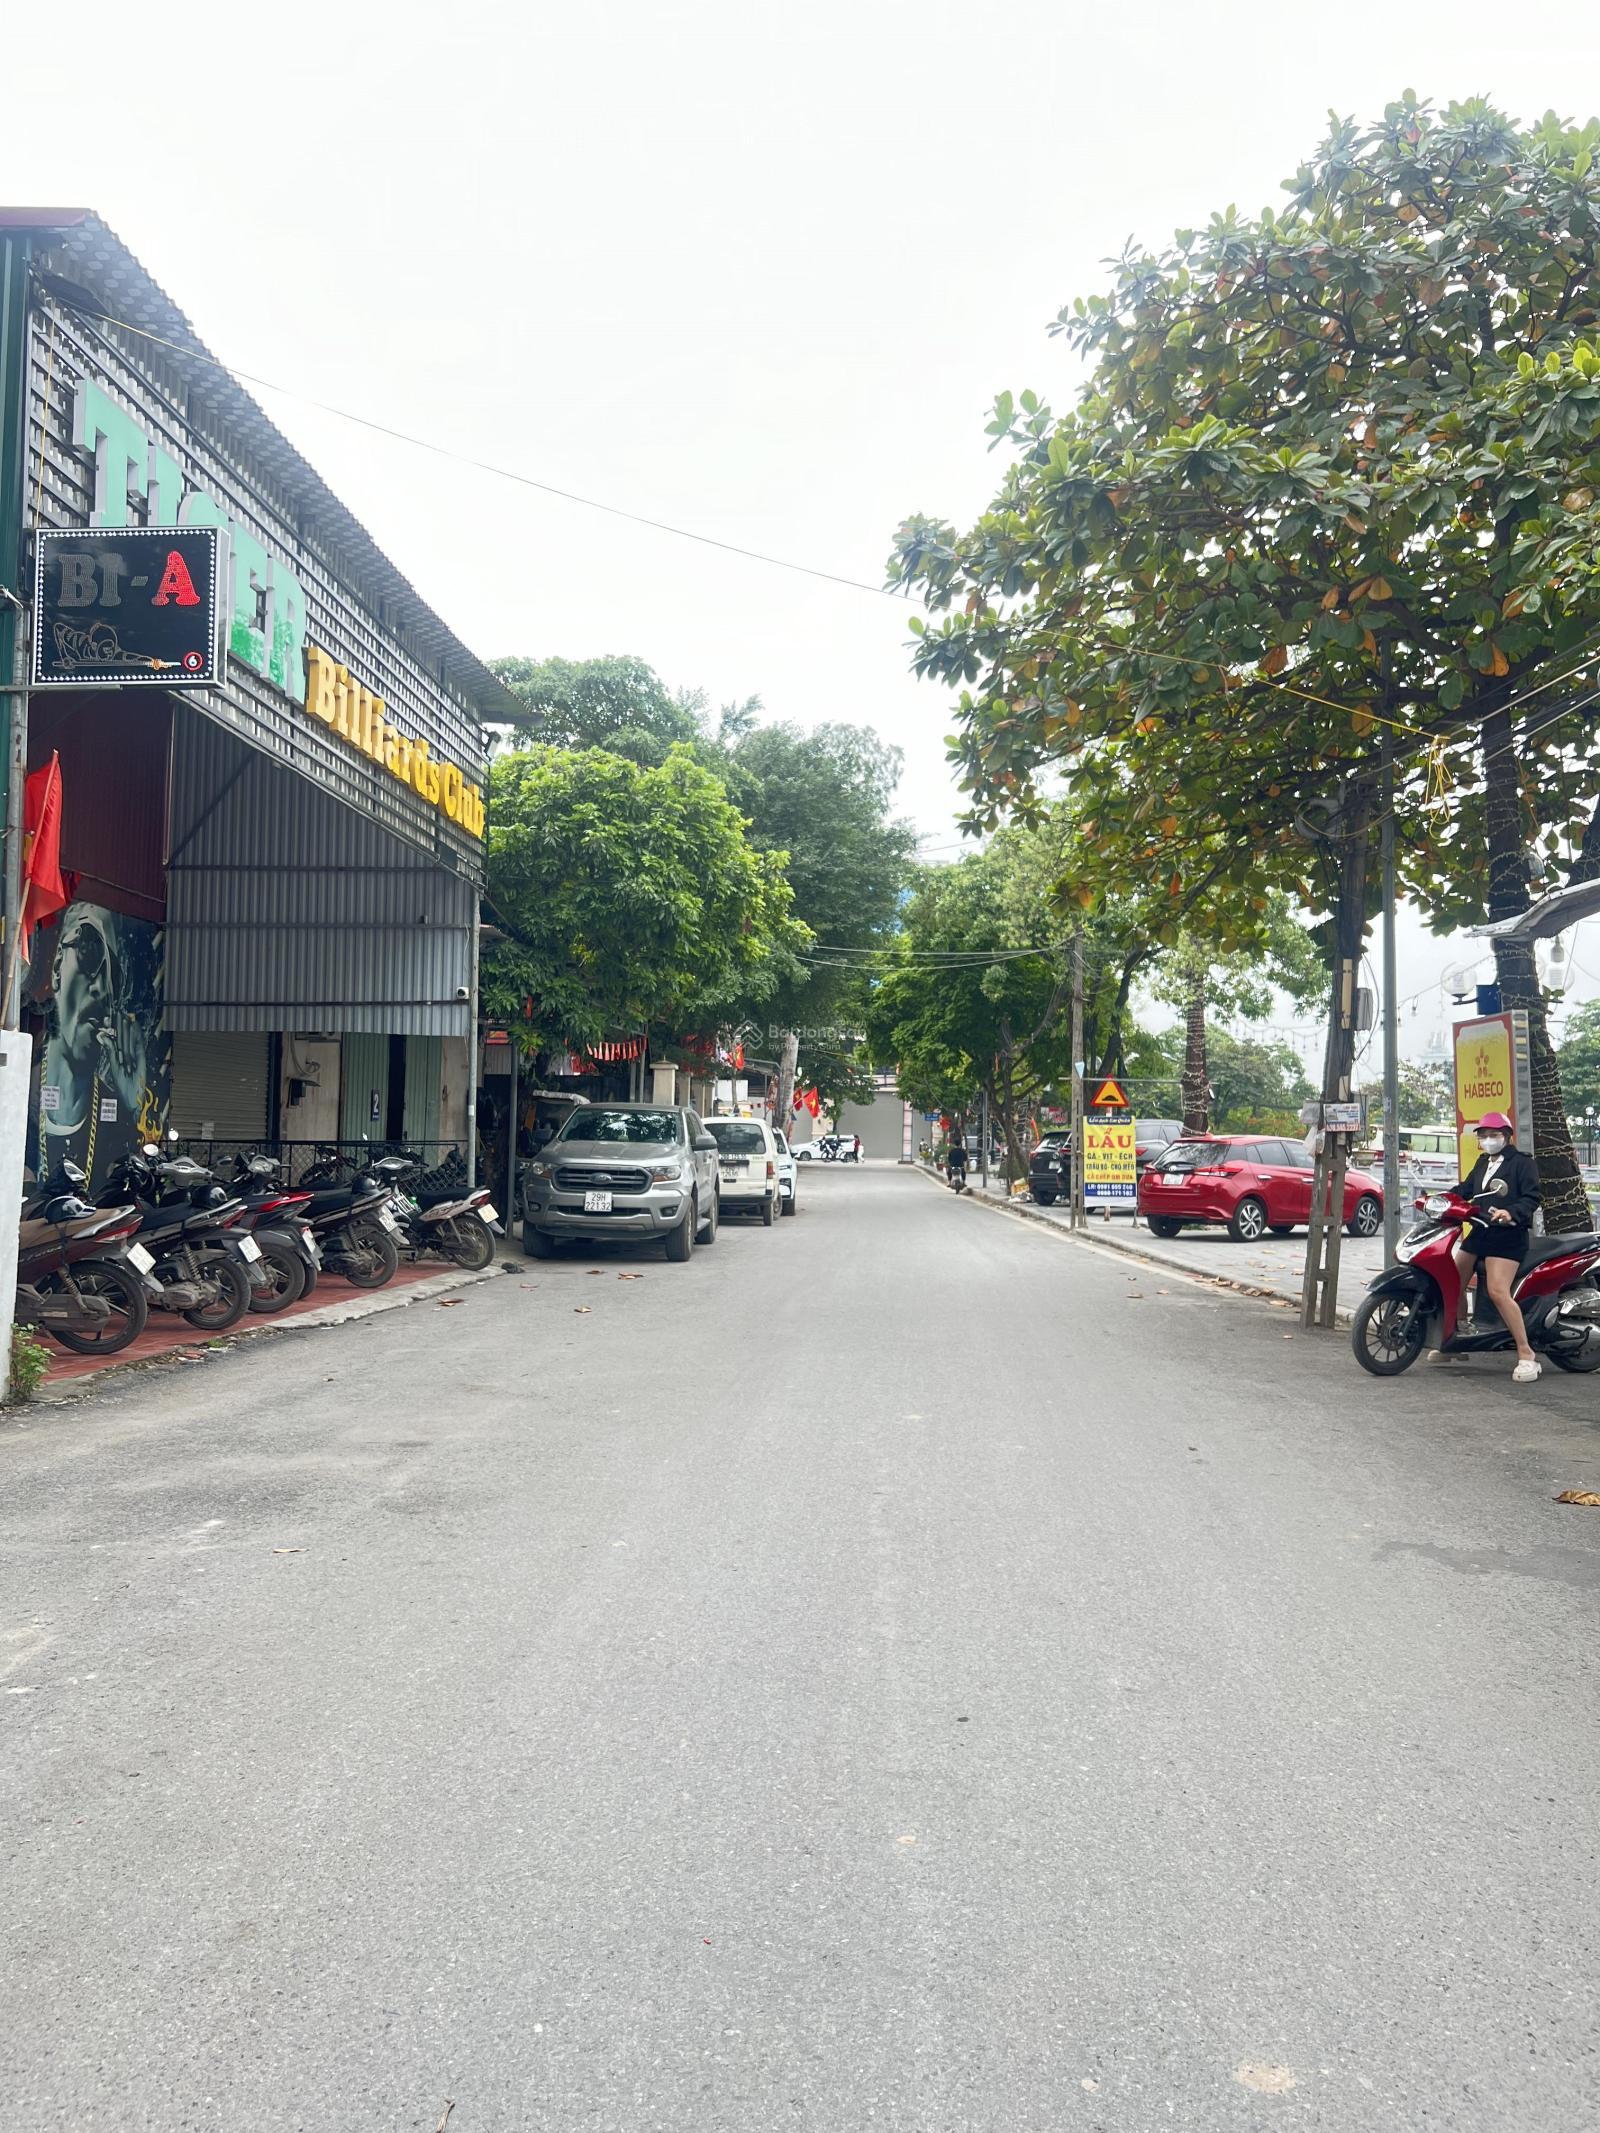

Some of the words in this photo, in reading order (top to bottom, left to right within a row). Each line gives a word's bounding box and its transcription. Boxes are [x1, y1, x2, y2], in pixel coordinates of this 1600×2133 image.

[306, 646, 439, 805] Billiards
[439, 761, 485, 839] Club
[1464, 1081, 1504, 1099] HABECO
[373, 1094, 379, 1113] 2
[591, 1192, 606, 1202] 29H
